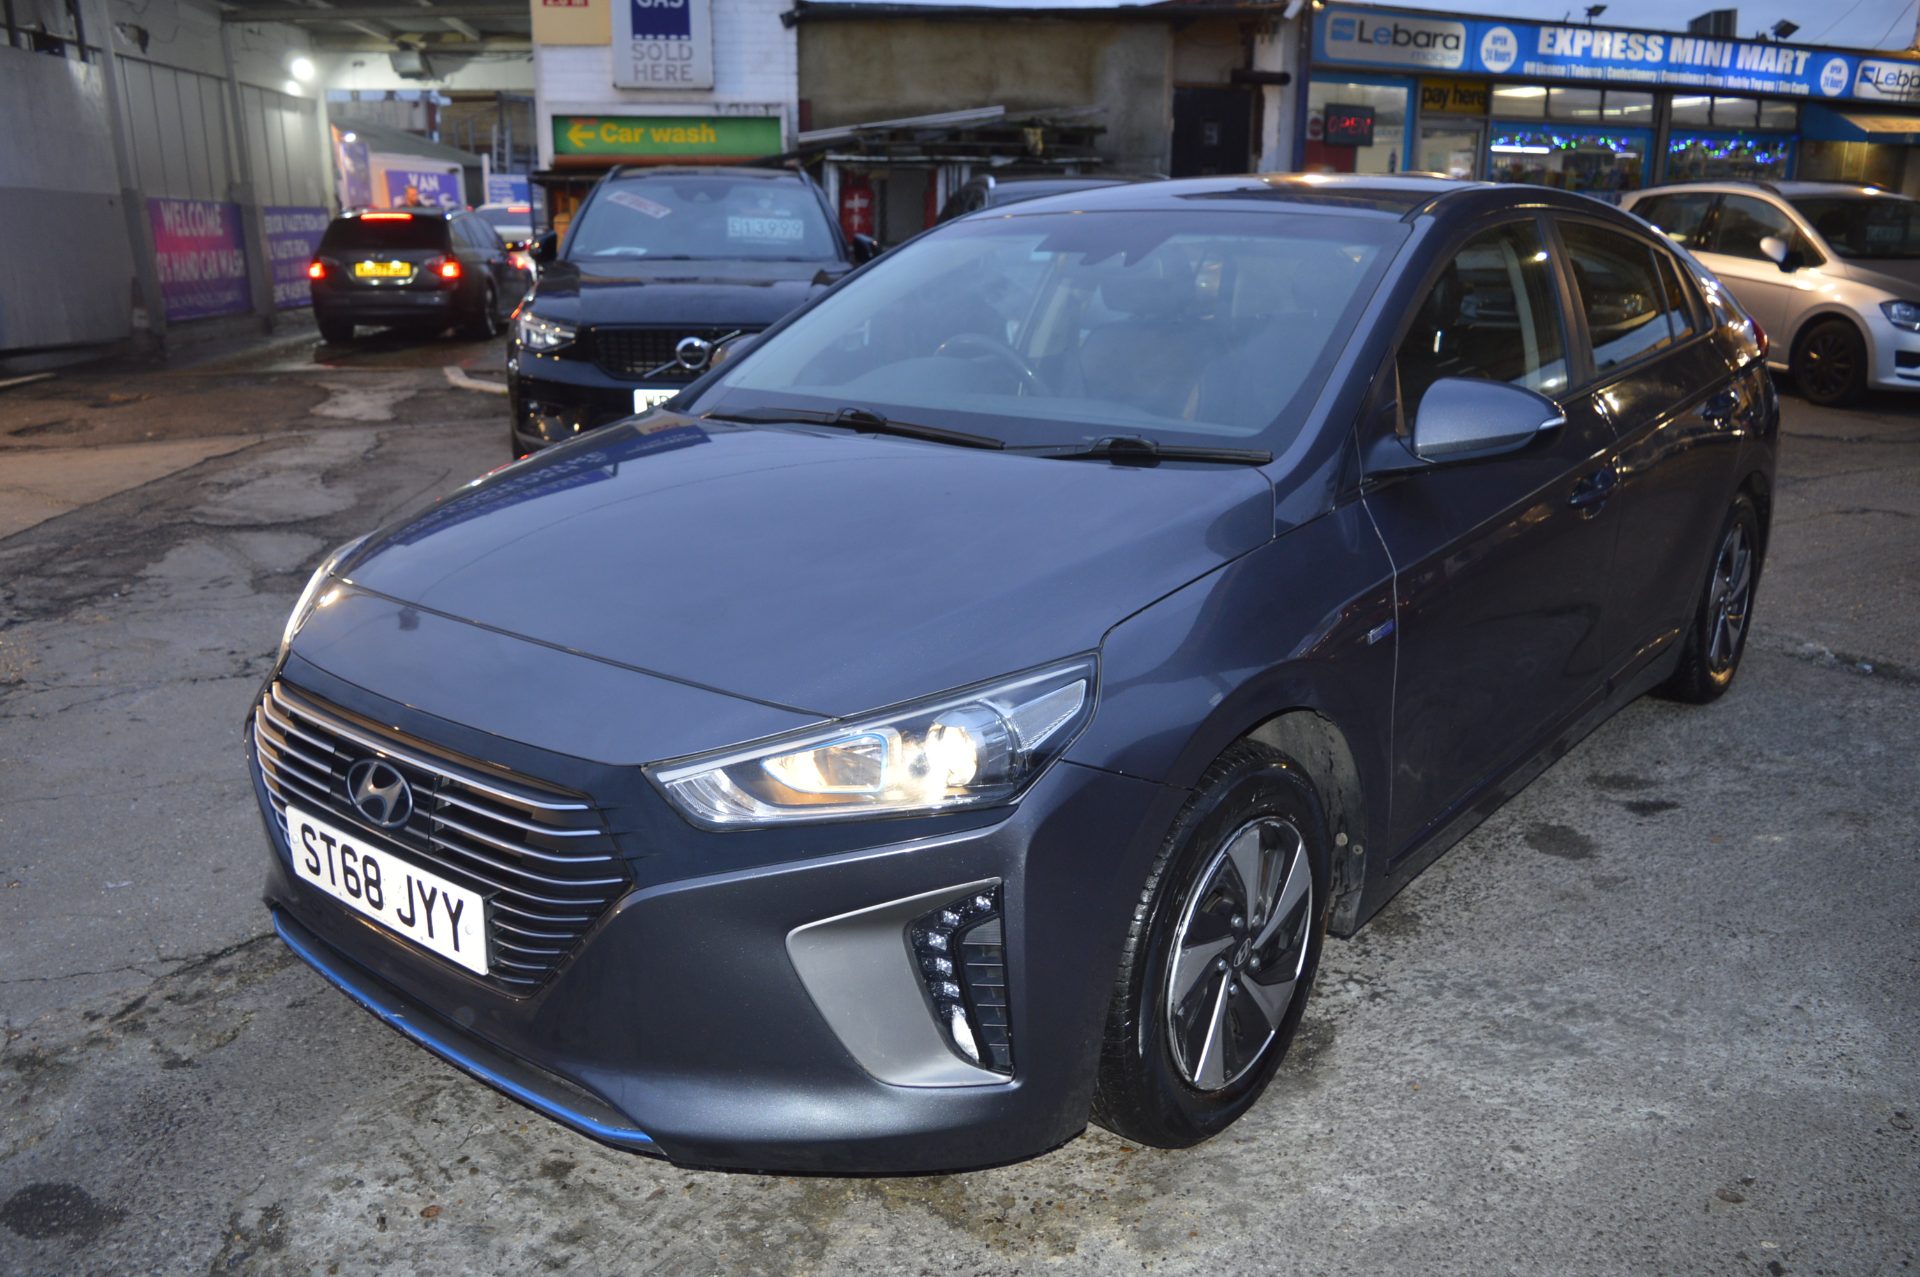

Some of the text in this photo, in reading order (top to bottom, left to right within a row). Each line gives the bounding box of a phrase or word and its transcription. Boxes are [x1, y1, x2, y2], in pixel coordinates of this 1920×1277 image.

[1358, 19, 1460, 50] Lebara
[632, 43, 693, 62] SOLD
[1537, 26, 1811, 76] EXPRESS MINI MART
[633, 64, 693, 82] HERE
[1423, 84, 1486, 109] pay here
[601, 123, 717, 144] Car wash
[1327, 115, 1372, 135] OPEN
[408, 173, 440, 192] VAN
[160, 200, 224, 236] WELCOME
[301, 824, 463, 952] ST68 JYY
